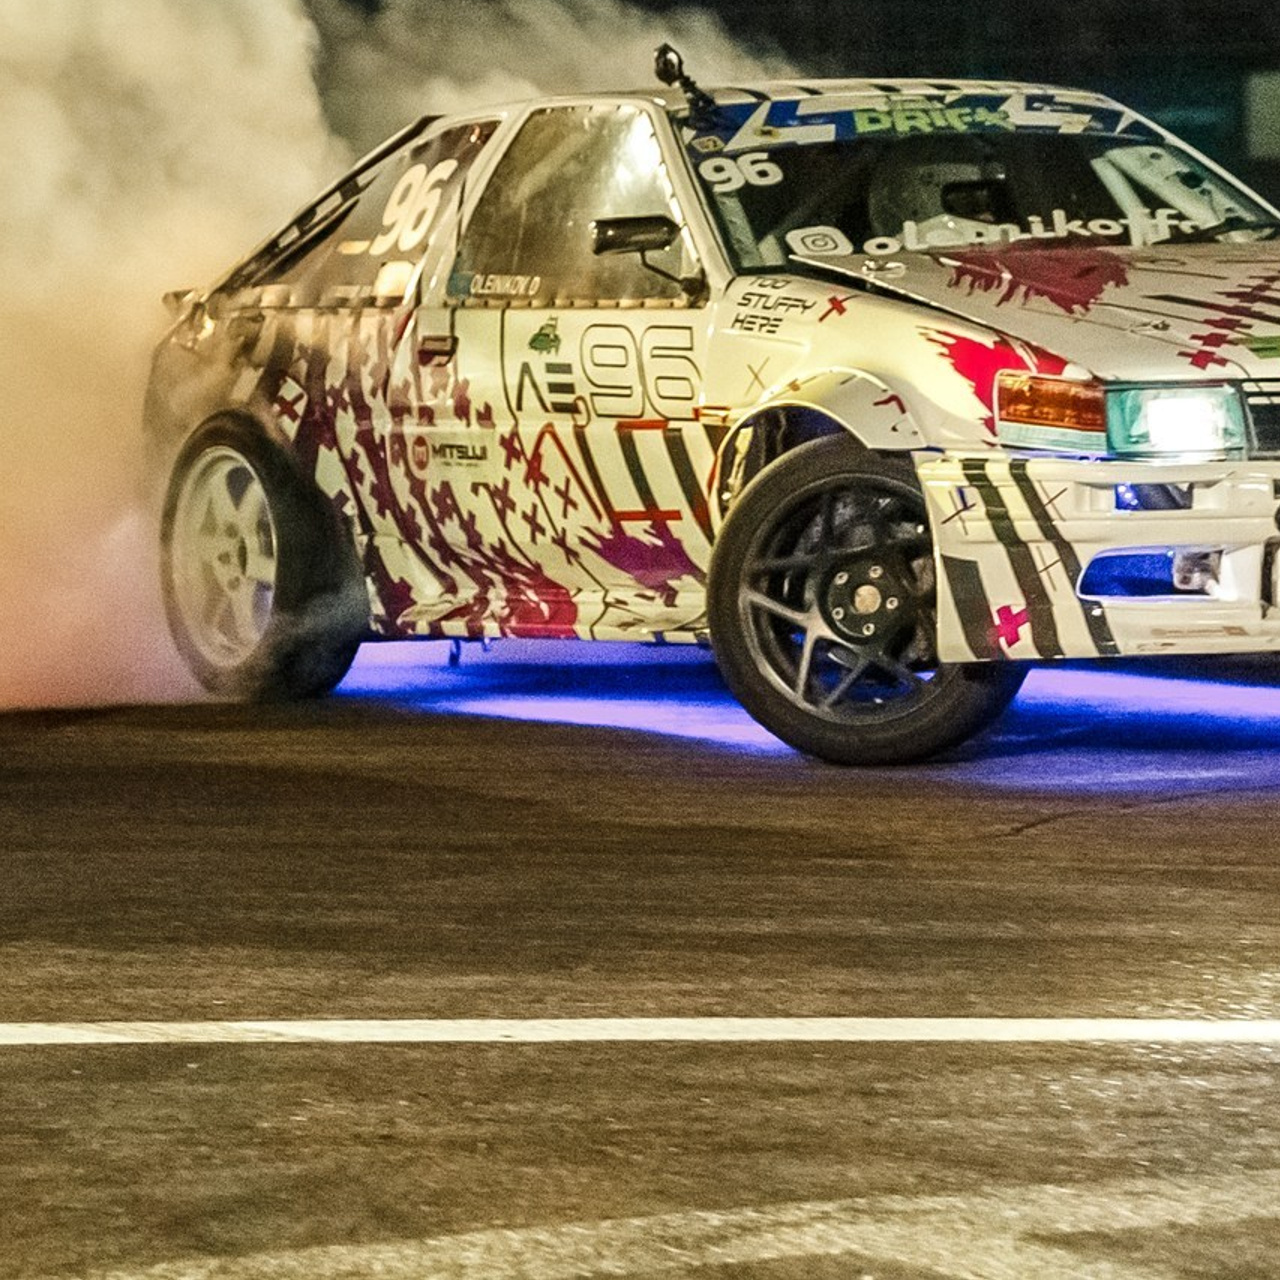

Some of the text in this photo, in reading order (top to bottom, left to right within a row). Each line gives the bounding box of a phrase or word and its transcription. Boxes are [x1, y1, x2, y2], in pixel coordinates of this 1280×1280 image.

[698, 151, 784, 193] 96
[368, 158, 459, 256] 96
[736, 291, 818, 315] STUFFY
[730, 312, 783, 334] HERE
